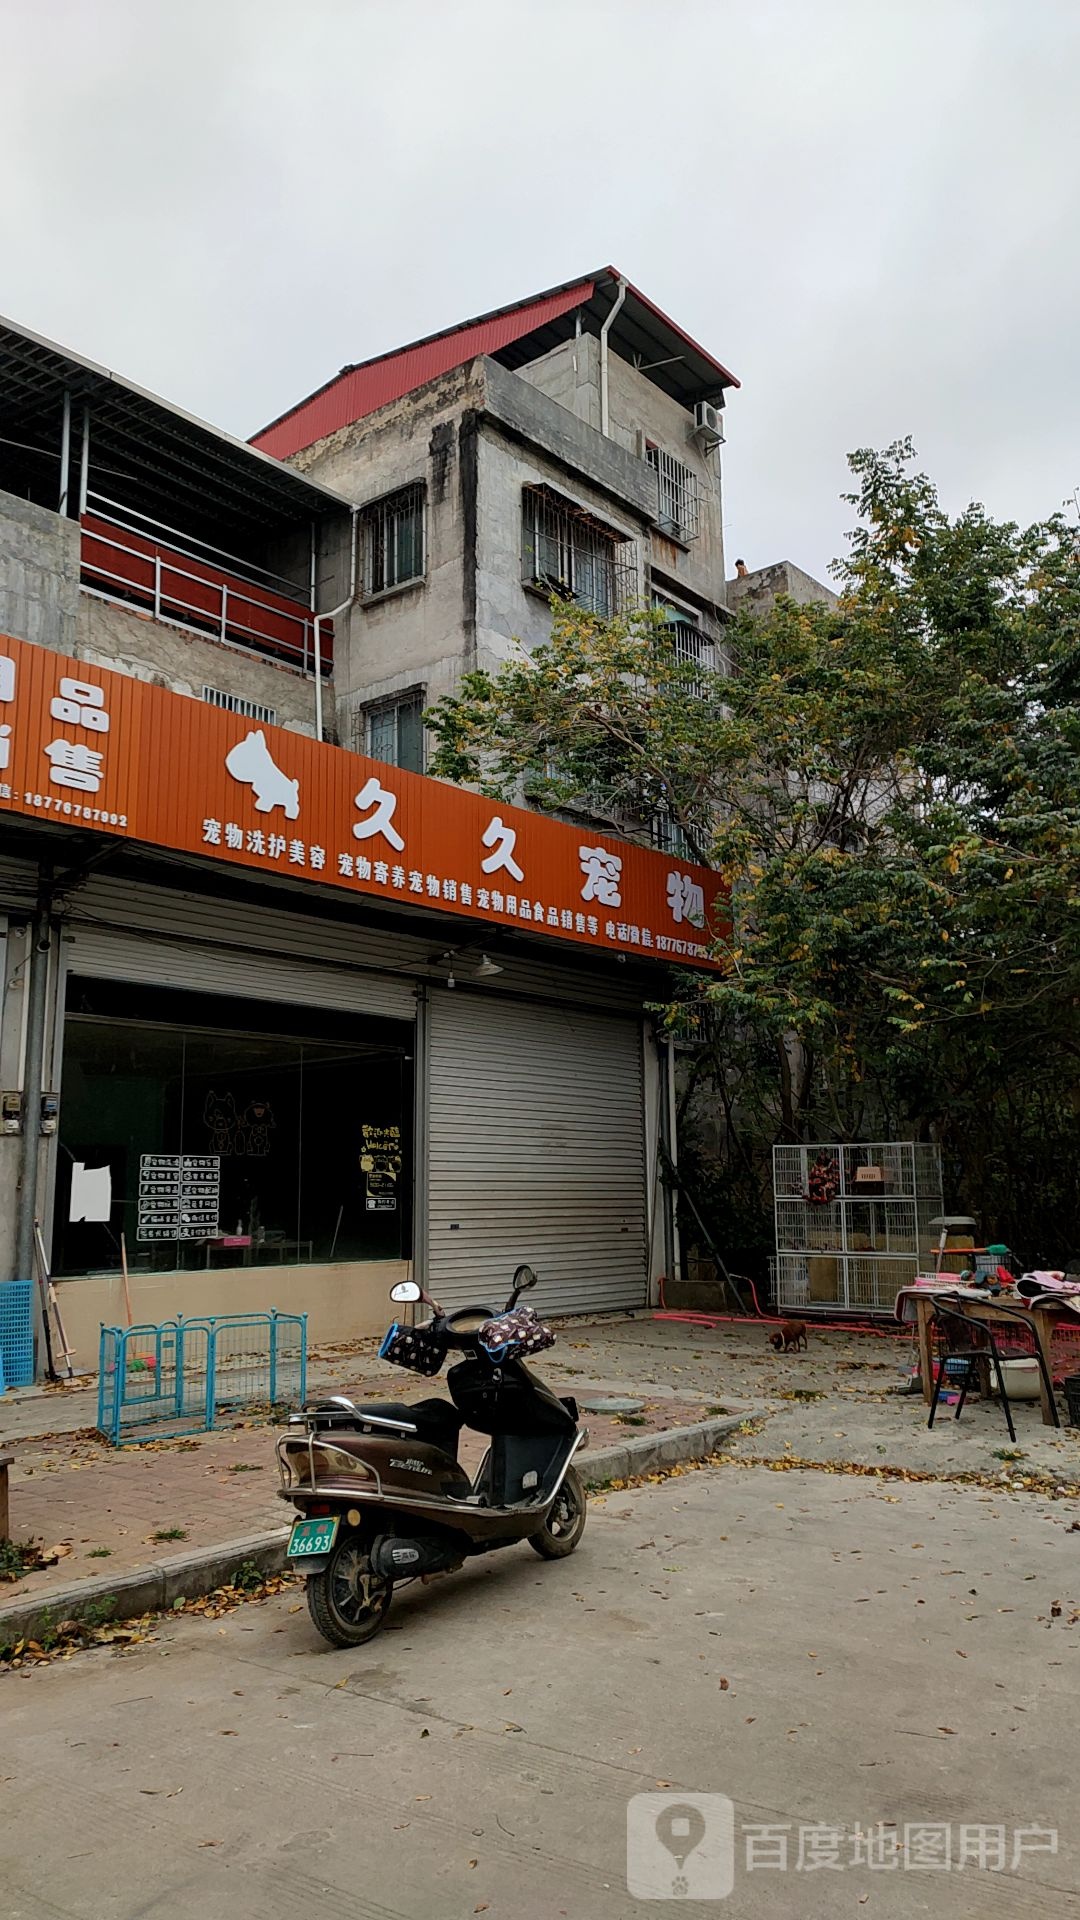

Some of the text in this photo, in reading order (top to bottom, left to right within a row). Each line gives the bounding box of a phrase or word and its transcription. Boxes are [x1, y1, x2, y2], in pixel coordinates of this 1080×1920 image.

[201, 817, 326, 870] 宠物洗护美容
[353, 776, 705, 929] 久久宠物
[290, 1535, 330, 1553] 36693
